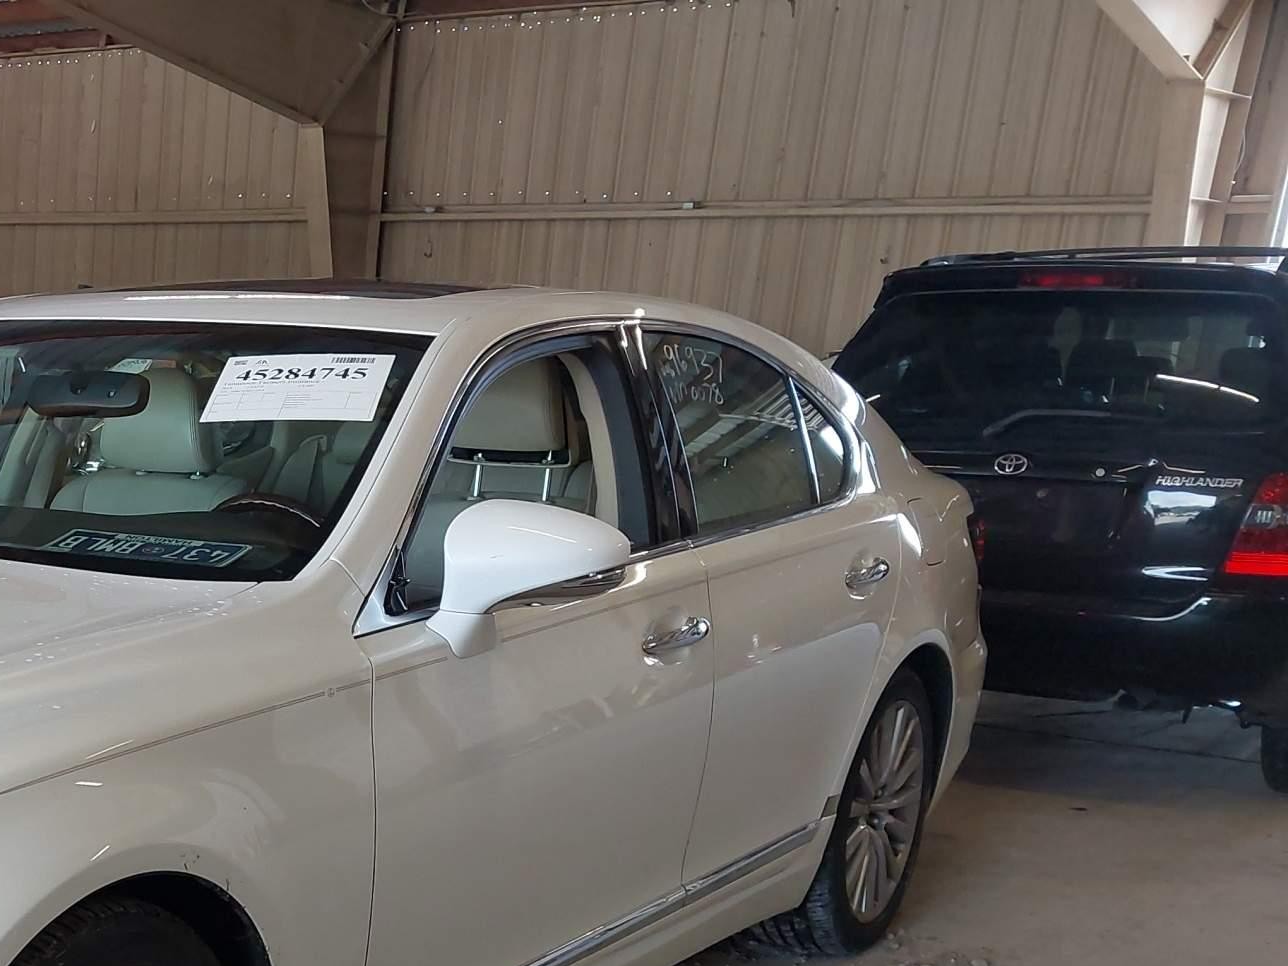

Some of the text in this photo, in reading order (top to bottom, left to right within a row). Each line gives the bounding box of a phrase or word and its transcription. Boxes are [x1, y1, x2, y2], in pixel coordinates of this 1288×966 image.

[236, 367, 368, 381] 45284745
[1155, 475, 1244, 488] HIGHLANDER
[161, 546, 231, 564] 437
